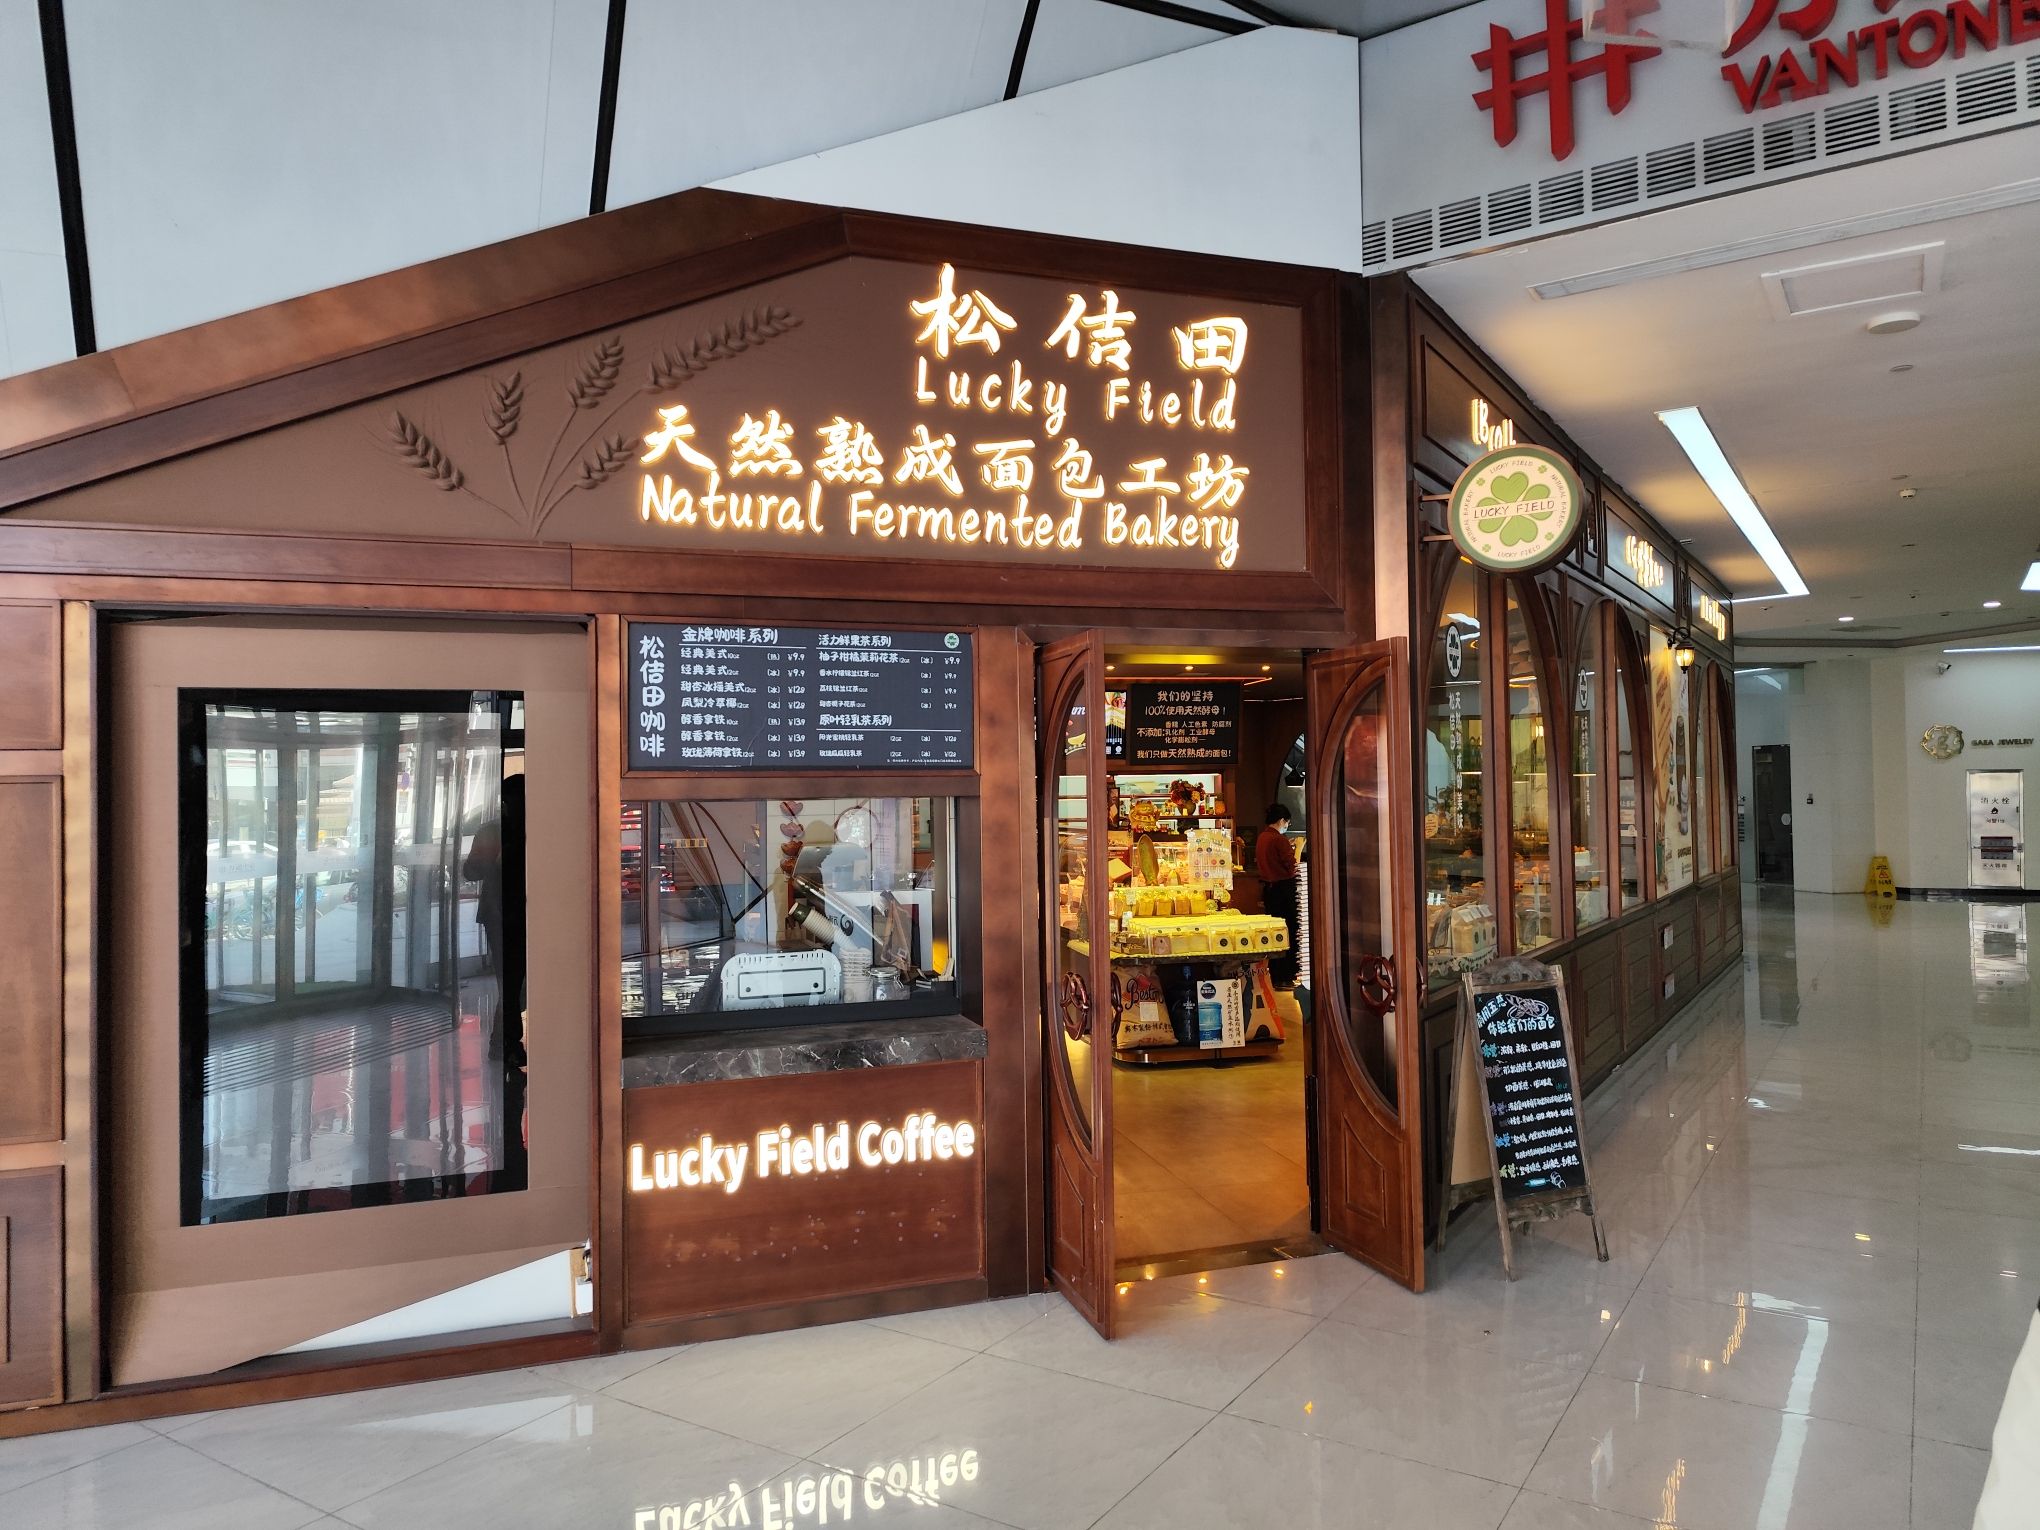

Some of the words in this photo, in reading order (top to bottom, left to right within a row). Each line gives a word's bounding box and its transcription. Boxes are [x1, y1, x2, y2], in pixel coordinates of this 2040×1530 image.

[909, 262, 1249, 374] 松佶田
[916, 358, 1067, 436] Lucky
[1104, 376, 1238, 431] Field
[639, 403, 1250, 512] 天然熟成面包工坊
[640, 473, 825, 536] Natural
[848, 488, 1085, 550] Fermented
[1102, 495, 1241, 570] Bakery
[1473, 505, 1510, 519] LUCKY
[1516, 500, 1555, 513] FIELD
[681, 626, 779, 645] 金牌咖啡系列
[818, 633, 892, 648] 活力鲜果茶系列
[639, 635, 666, 758] 松佶田咖啡
[819, 713, 893, 727] 原叶轻乳茶系列
[1157, 690, 1214, 702] 我们的坚持
[1487, 1014, 1555, 1036] 体验我们的面包
[630, 1134, 749, 1194] Lucky
[757, 1121, 849, 1178] Field
[858, 1112, 976, 1167] Coffee
